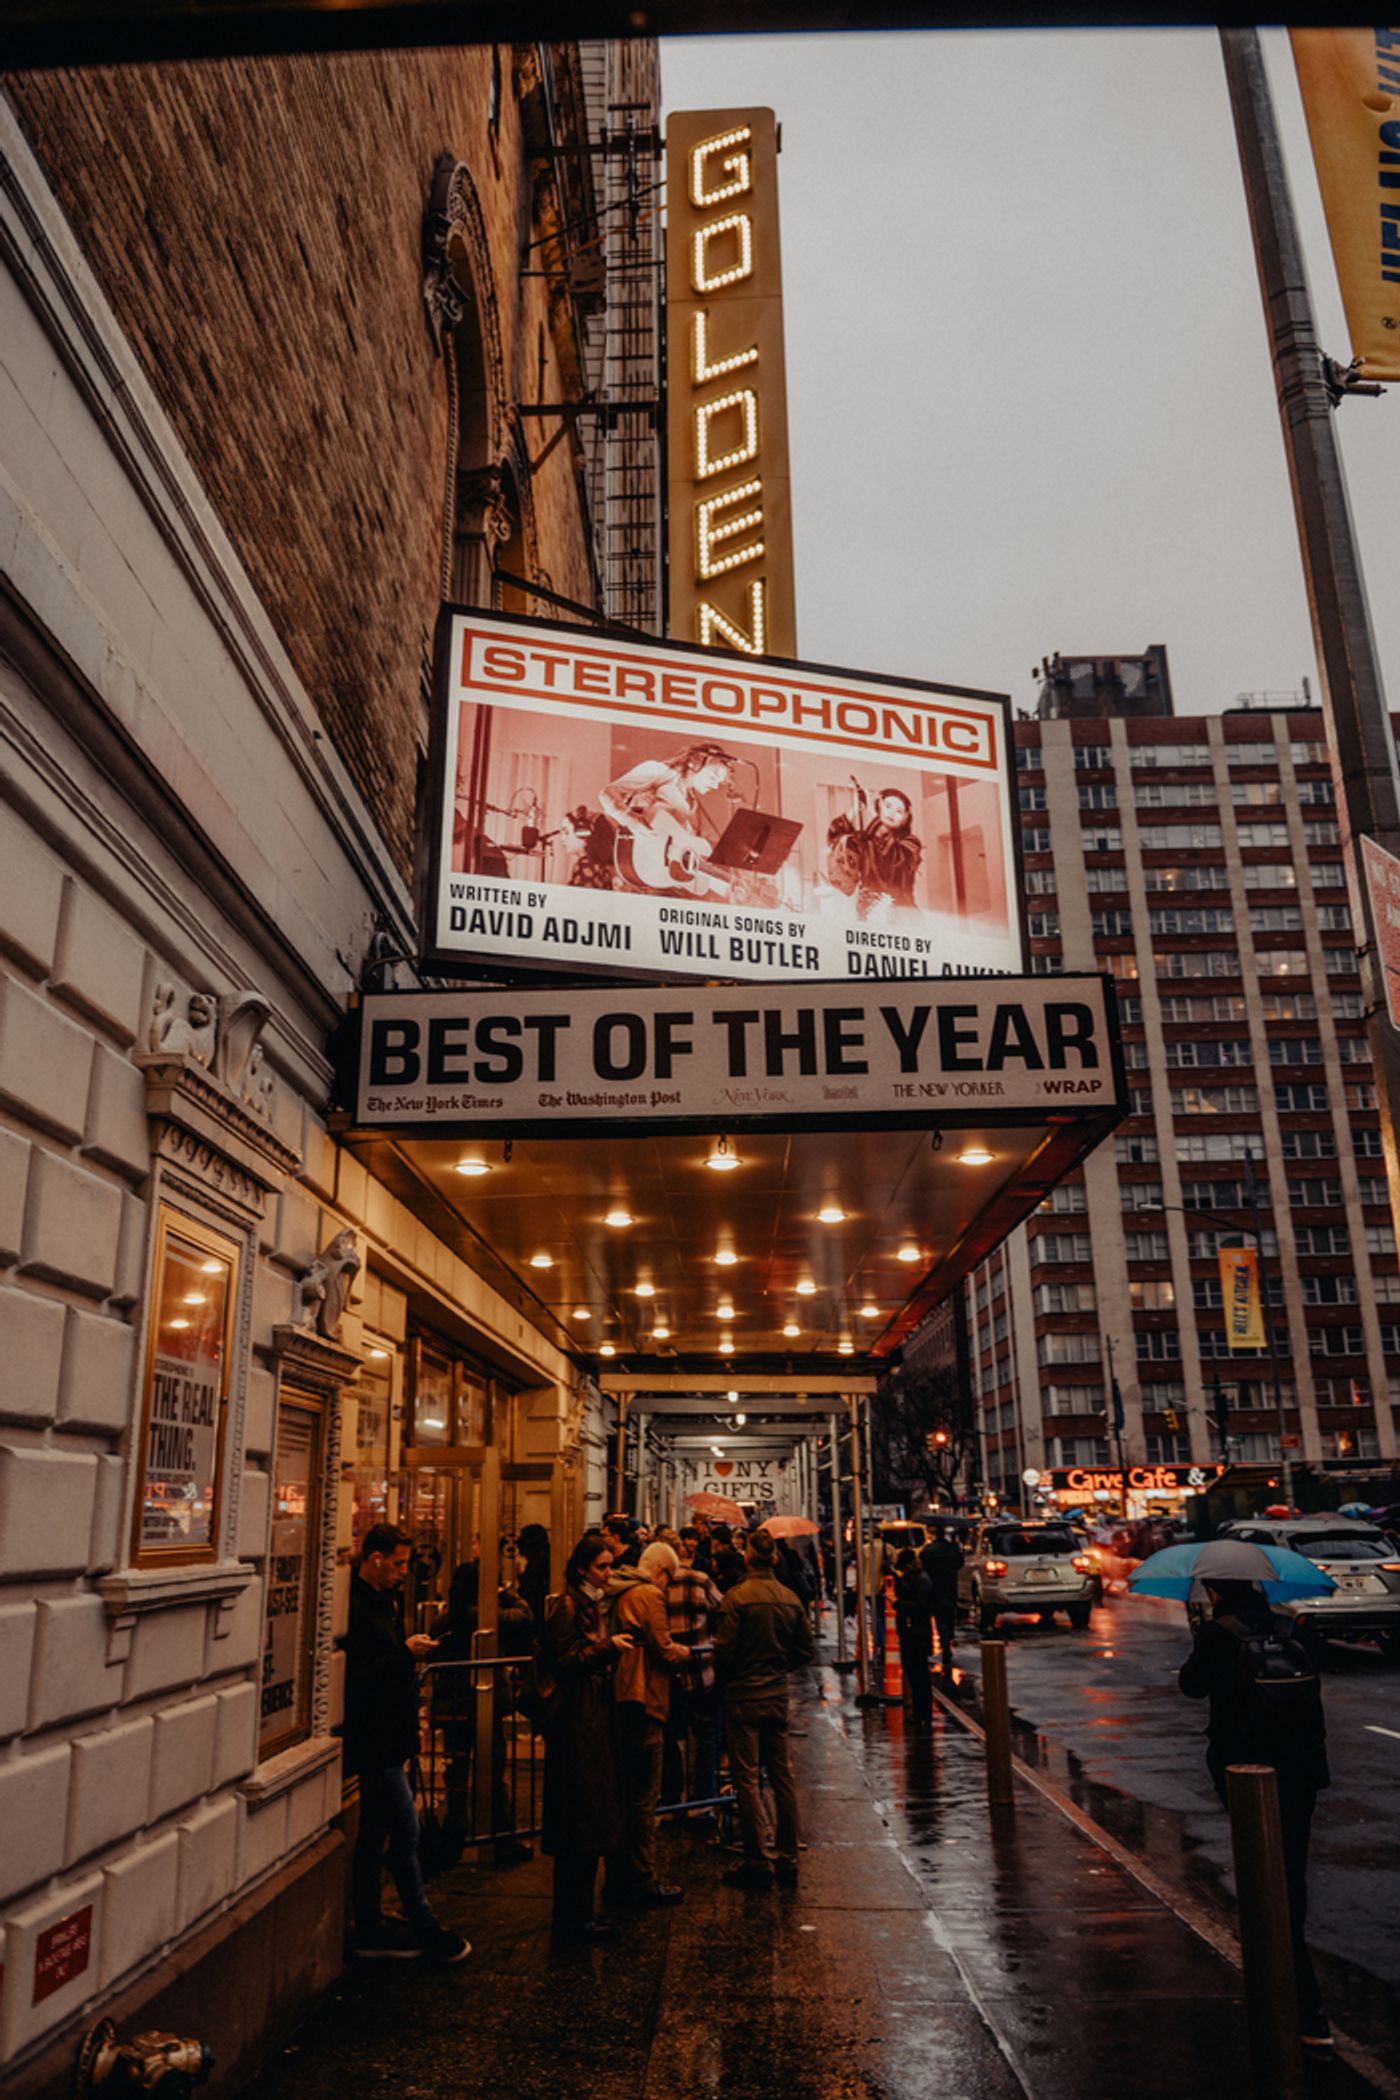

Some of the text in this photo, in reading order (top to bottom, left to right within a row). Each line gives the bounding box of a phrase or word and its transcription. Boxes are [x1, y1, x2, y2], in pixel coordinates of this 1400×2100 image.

[688, 123, 766, 655] GOLDEN
[482, 645, 980, 754] STEREOPHONIC
[450, 883, 547, 908] WRITTEN BY
[450, 906, 631, 950] DAVID ADJMI
[659, 907, 806, 938] ORIGINAL SONGS BY
[660, 929, 820, 971] WILL BUTLER
[846, 930, 932, 953] DIRECTED BY
[369, 1002, 1099, 1086] BEST OF THE YEAR
[538, 1090, 682, 1108] The Washington Post
[892, 1081, 1005, 1097] THE NEW YORKER
[1043, 1080, 1102, 1094] WRAP
[366, 1094, 504, 1114] The New York Times
[152, 1374, 214, 1427] THE REAL
[704, 1460, 774, 1478] I NY
[1128, 1467, 1178, 1488] Cafe
[703, 1482, 774, 1500] GIFTS
